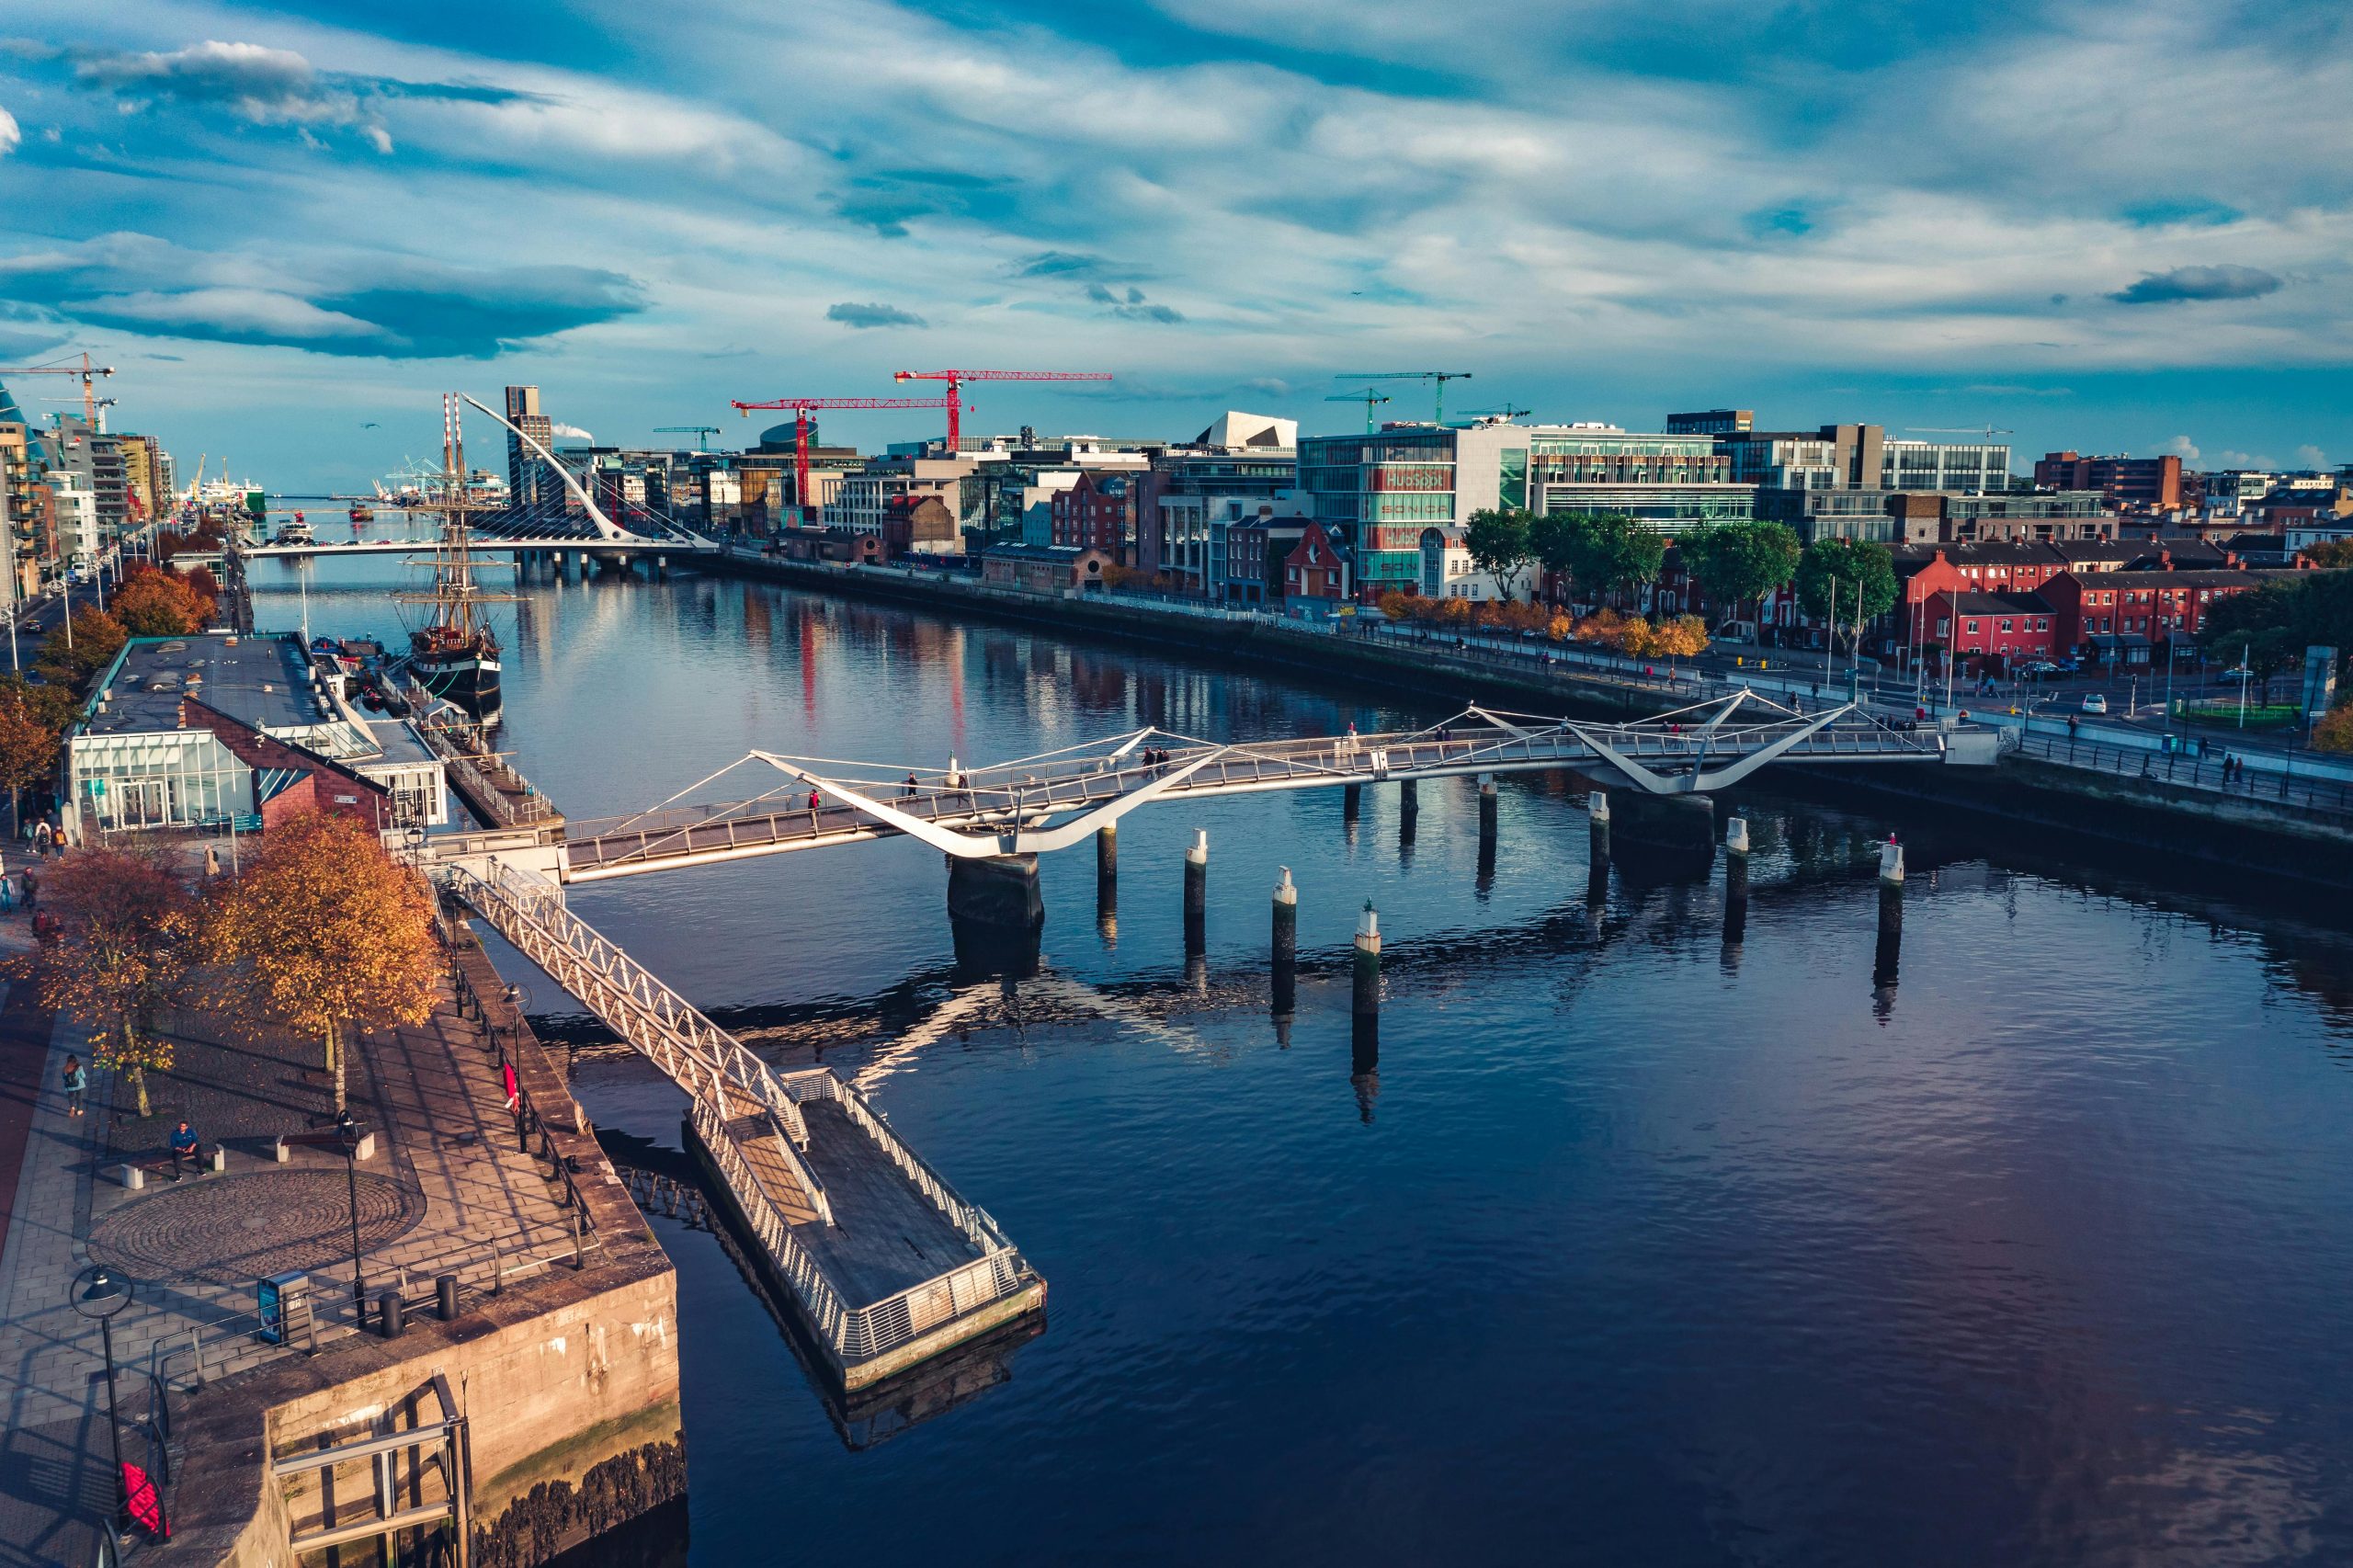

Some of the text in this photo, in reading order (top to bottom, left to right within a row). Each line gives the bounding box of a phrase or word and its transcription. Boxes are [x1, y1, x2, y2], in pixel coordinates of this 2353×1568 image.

[1387, 472, 1443, 487] HubSpot
[1381, 505, 1449, 514] SONCA
[1386, 531, 1419, 545] HubS
